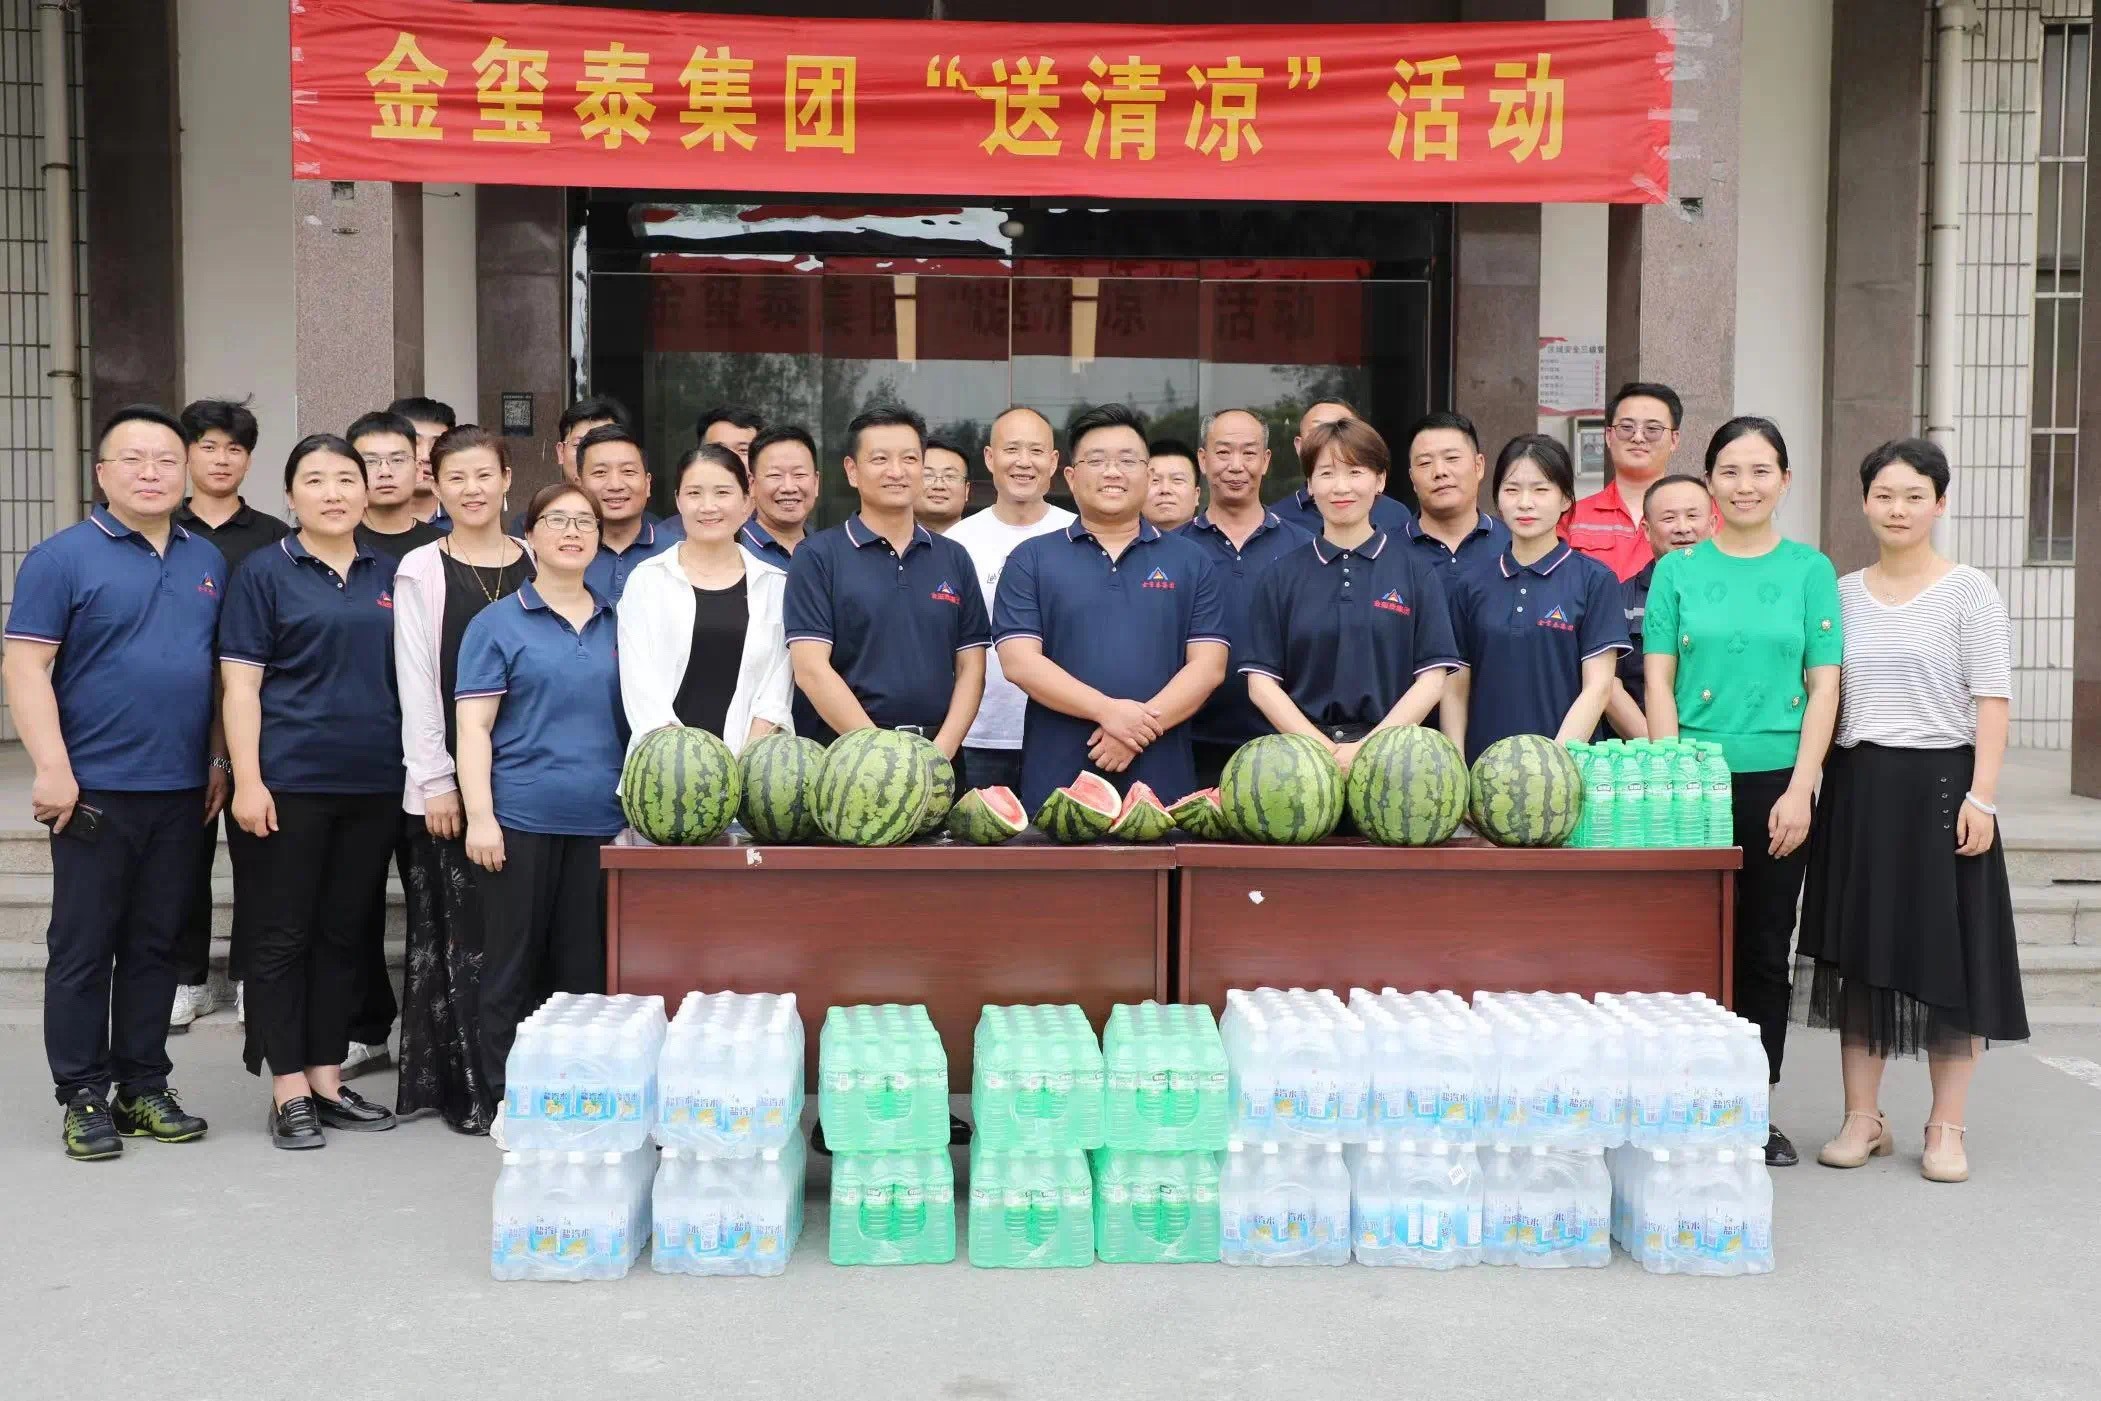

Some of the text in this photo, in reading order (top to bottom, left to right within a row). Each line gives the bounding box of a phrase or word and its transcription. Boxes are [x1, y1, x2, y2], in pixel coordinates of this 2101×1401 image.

[365, 32, 857, 153] 金玺泰集团
[1386, 53, 1566, 163] 活动
